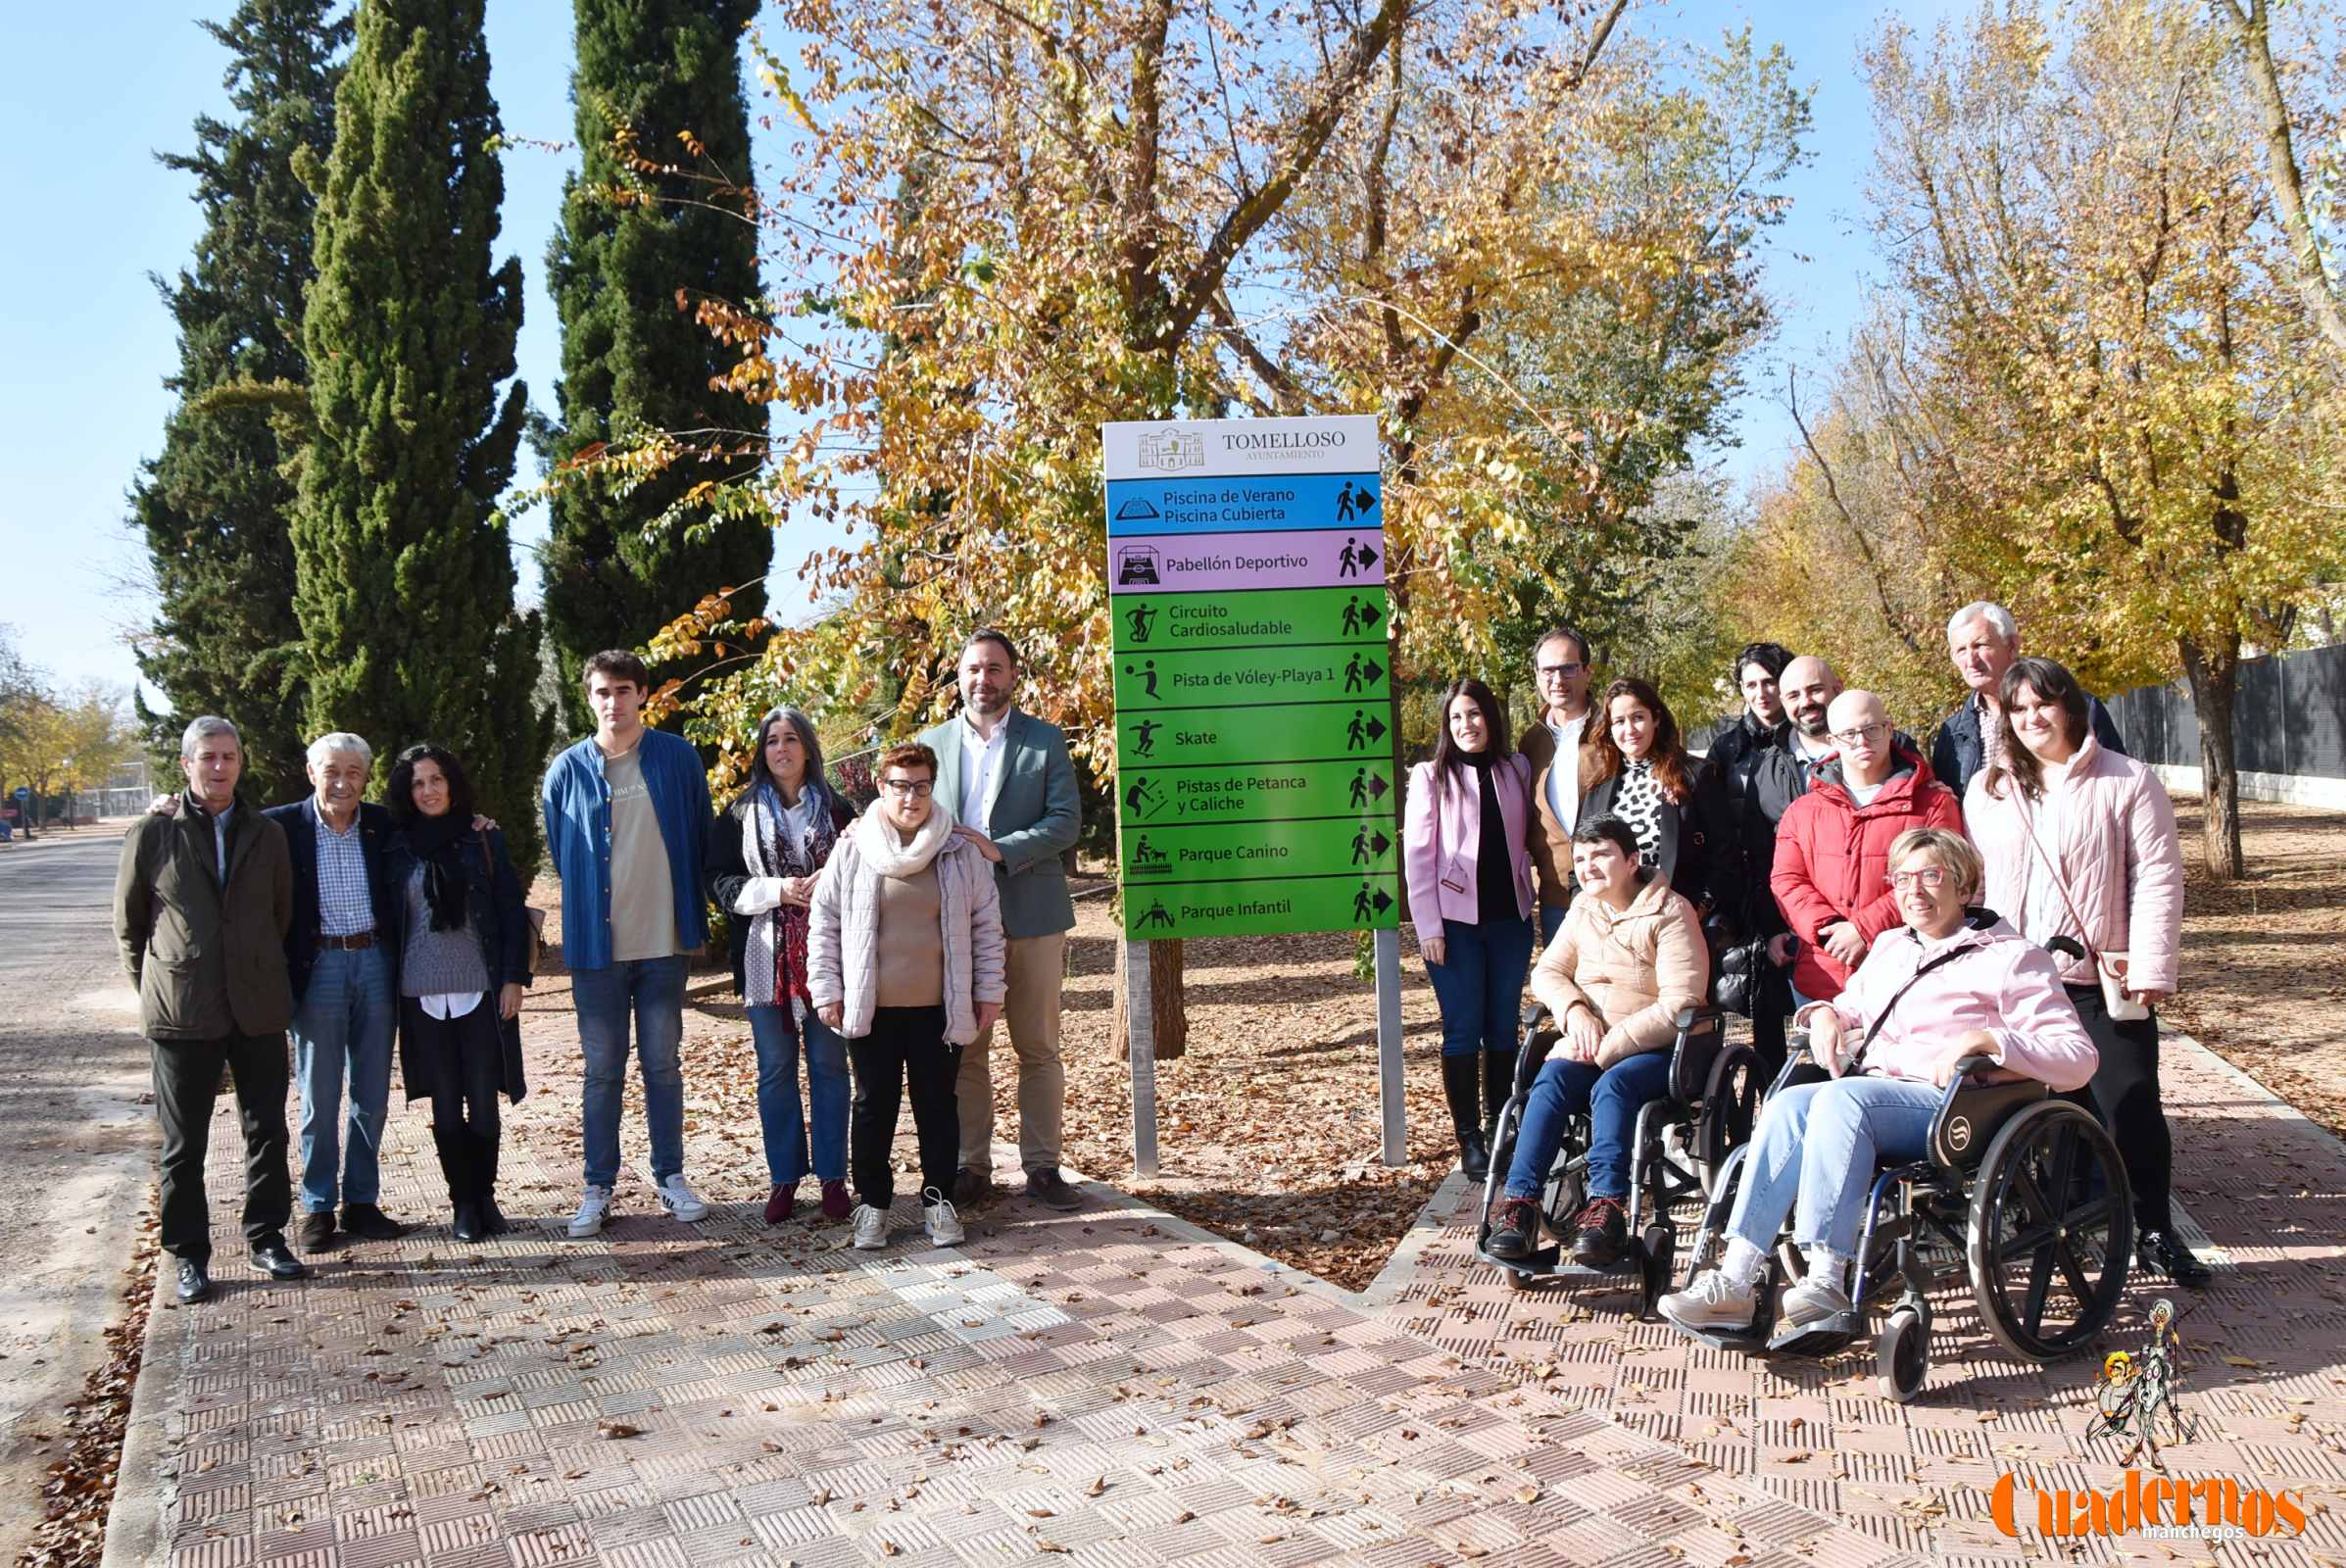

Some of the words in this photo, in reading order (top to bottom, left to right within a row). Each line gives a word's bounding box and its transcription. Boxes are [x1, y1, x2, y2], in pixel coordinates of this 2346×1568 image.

[1222, 430, 1346, 451] TOMELLOSO
[1246, 450, 1325, 462] AYUNTAMIENTO
[1163, 491, 1217, 506] Piscina
[1220, 490, 1240, 504] de
[1242, 489, 1295, 503] Verano
[1164, 509, 1218, 524] Piscina
[1221, 507, 1286, 522] Cubierta
[1166, 555, 1231, 572] Pabellón
[1235, 554, 1308, 571] Deportivo
[1169, 605, 1228, 619] Circuito
[1170, 622, 1293, 637] Cardiosaludable
[1173, 672, 1211, 687] Pista
[1213, 671, 1232, 685] de
[1236, 668, 1322, 687] Vóley-Playa
[1326, 668, 1336, 681] 1
[1175, 732, 1217, 746] Skate
[1176, 779, 1221, 794] Pistas
[1225, 778, 1244, 792] de
[1246, 776, 1306, 791] Petanca
[1177, 801, 1186, 814] y
[1190, 797, 1245, 812] Caliche
[1179, 848, 1233, 863] Parque
[1236, 844, 1289, 859] Canino
[1181, 904, 1235, 919] Parque
[1238, 899, 1292, 915] Infantil
